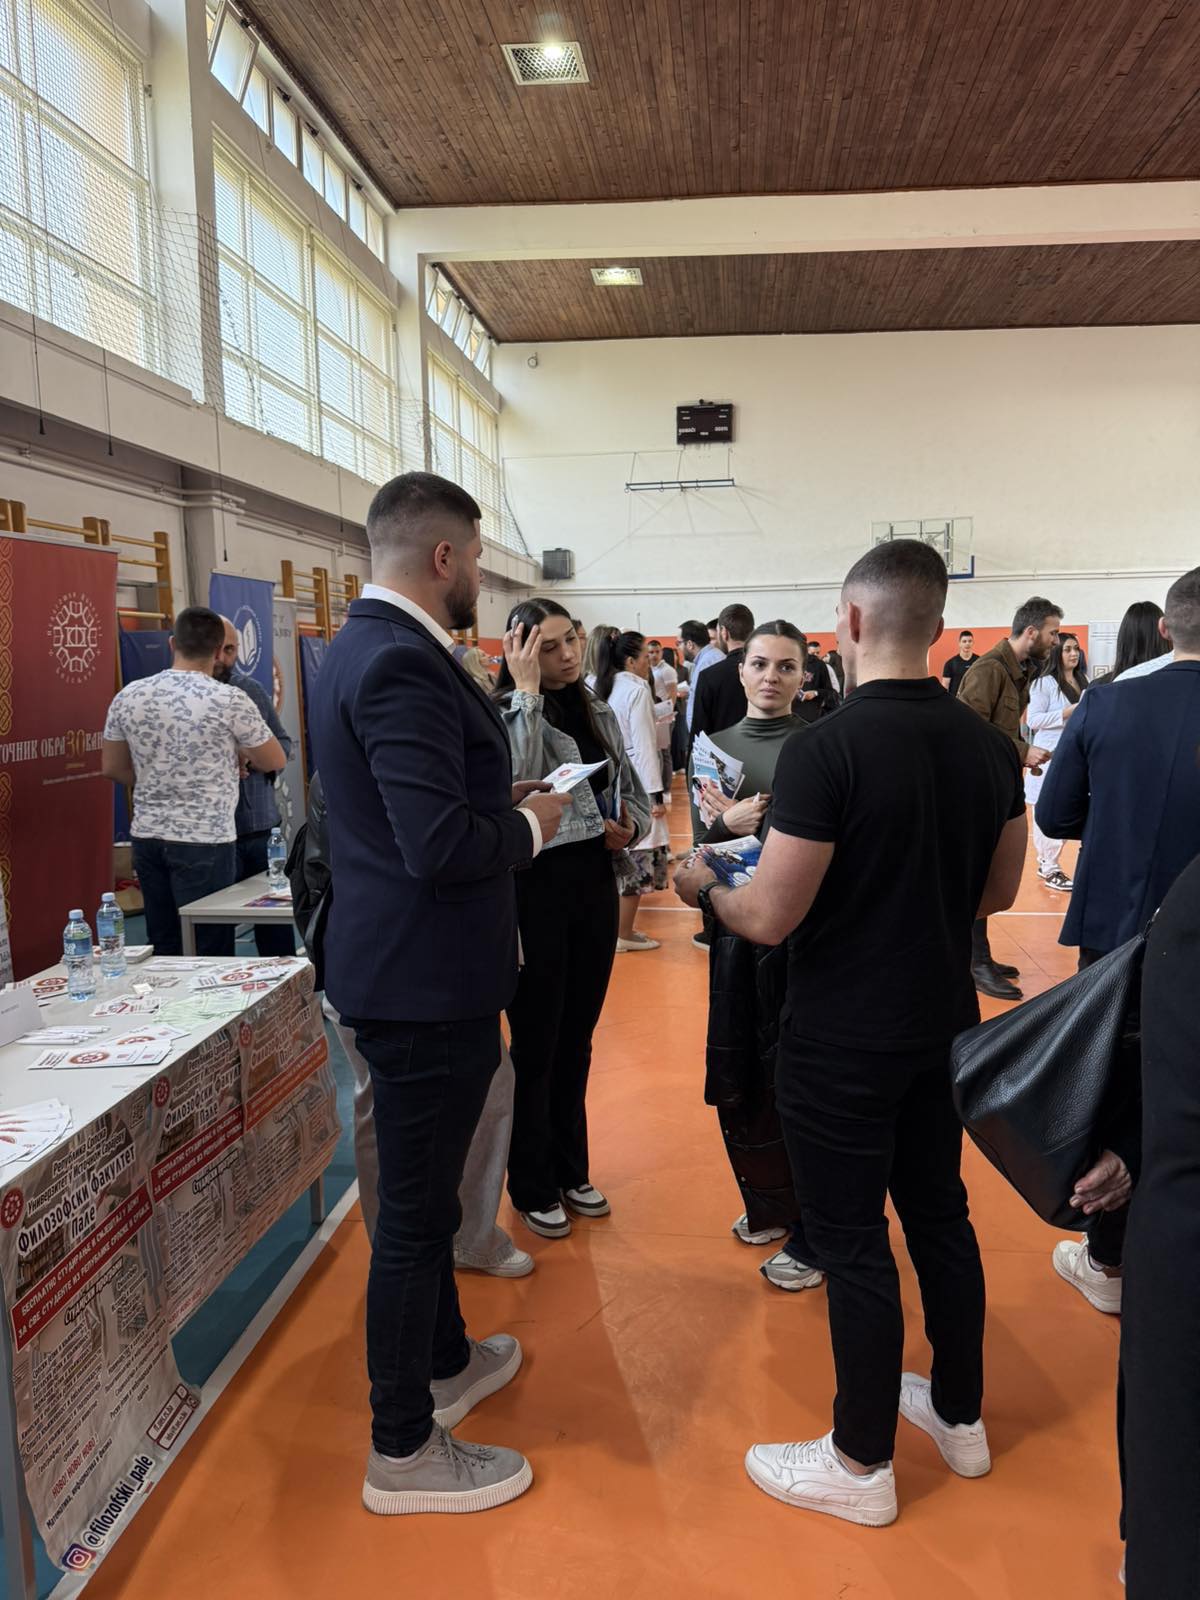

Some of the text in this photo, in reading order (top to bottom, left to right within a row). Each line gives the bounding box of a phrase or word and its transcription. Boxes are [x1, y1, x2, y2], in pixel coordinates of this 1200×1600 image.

[53, 1143, 86, 1175] Република
[18, 1186, 90, 1252] Филозофски
[28, 1175, 69, 1214] Универзитет
[71, 1206, 96, 1238] Пале
[18, 1324, 28, 1339] ЗА
[29, 1311, 41, 1329] СВЕ
[42, 1279, 72, 1315] СТУДЕНТЕ
[72, 1272, 81, 1286] ИЗ
[81, 1241, 111, 1276] РЕПУБЛИКЕ
[22, 1276, 57, 1316] БЕСПЛАТНО
[57, 1242, 92, 1281] СТУДИРАЊЕ
[52, 1474, 69, 1498] НОВО!
[68, 1457, 83, 1478] НОВО!
[82, 1455, 154, 1548] @filozofski_pale
